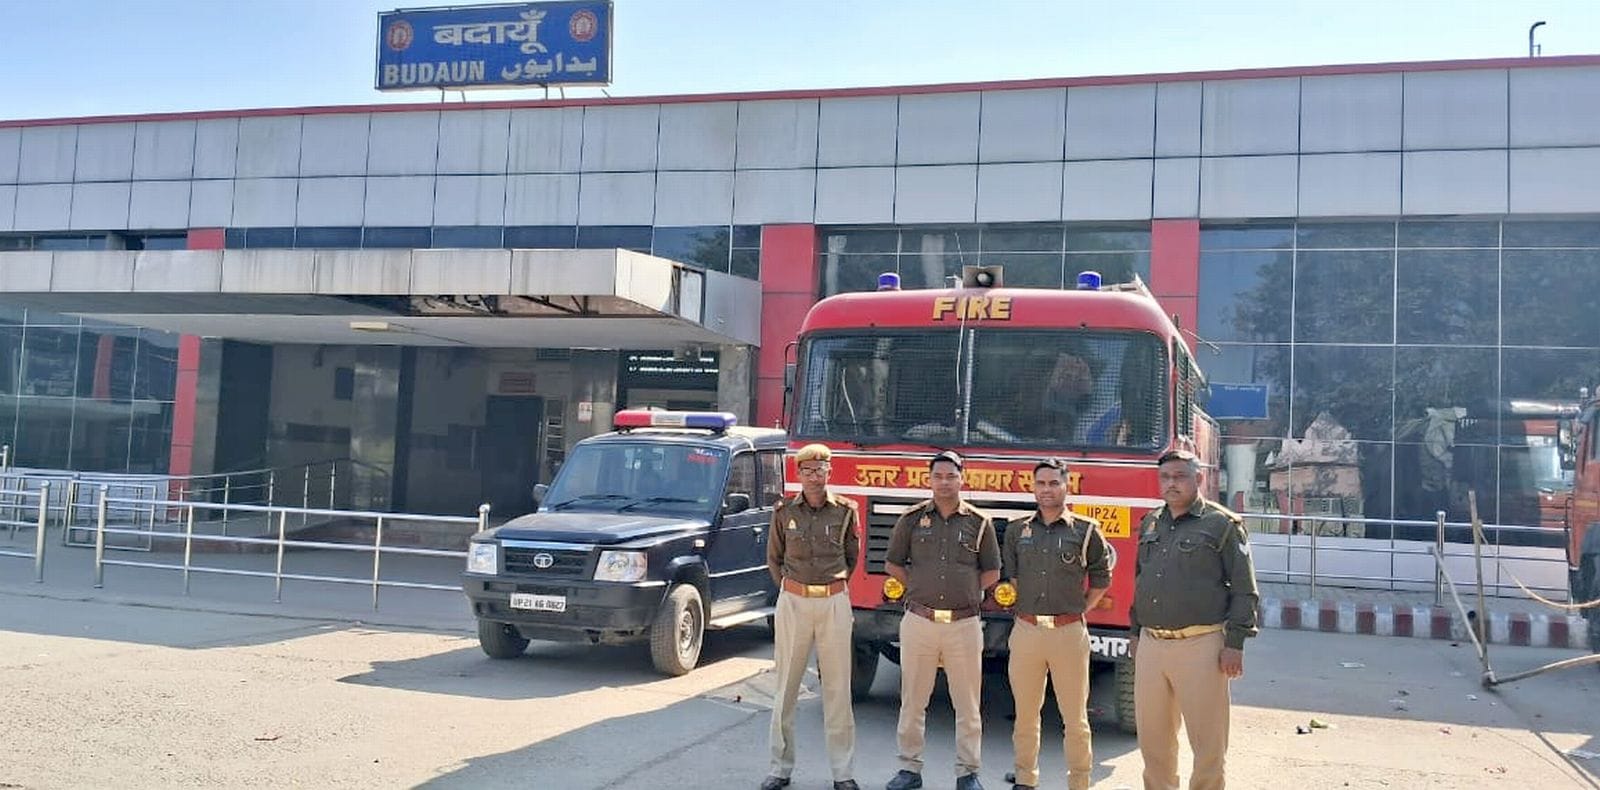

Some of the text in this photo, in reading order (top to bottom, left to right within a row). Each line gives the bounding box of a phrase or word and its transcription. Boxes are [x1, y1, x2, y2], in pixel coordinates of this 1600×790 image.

[432, 9, 548, 54] बदायूँ
[383, 60, 485, 85] BUDAUN
[933, 296, 1011, 321] FIRE
[855, 464, 901, 487] उत्तर
[1086, 506, 1118, 520] UP24
